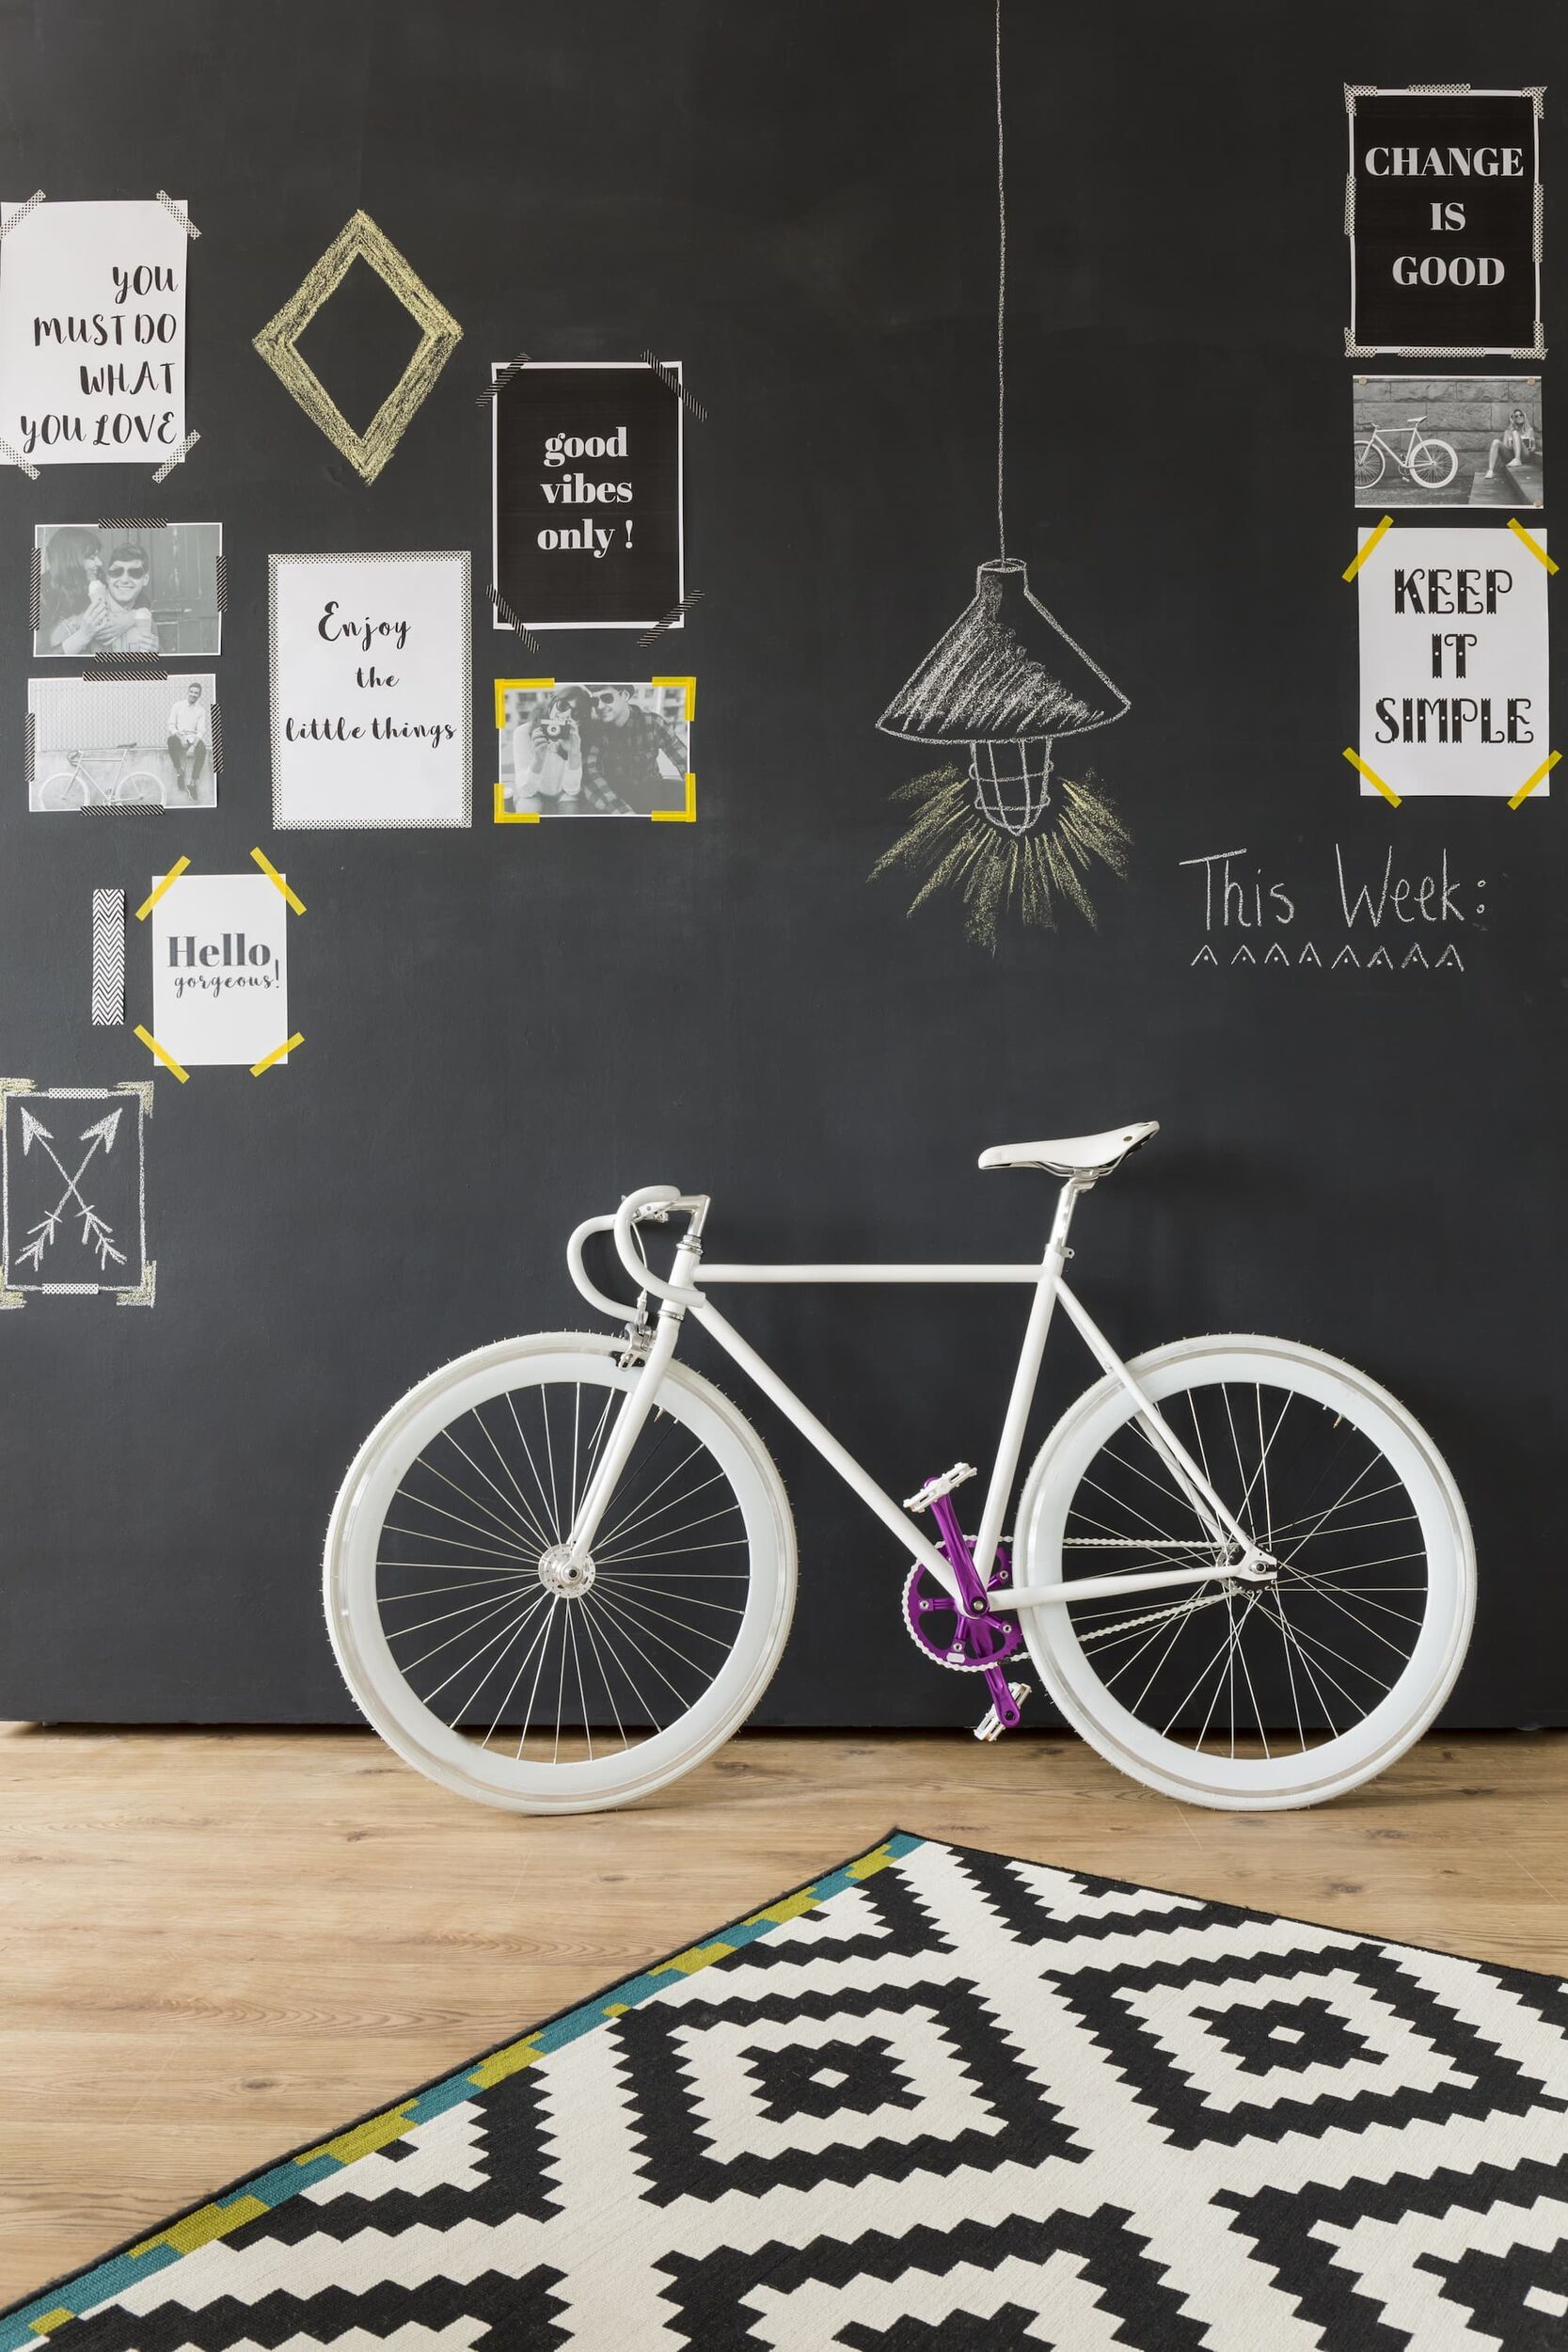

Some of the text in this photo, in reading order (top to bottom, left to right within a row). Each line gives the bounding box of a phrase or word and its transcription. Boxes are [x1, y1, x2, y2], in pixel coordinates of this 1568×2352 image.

[1365, 147, 1524, 177] CHANGE
[1429, 202, 1466, 231] IS
[112, 265, 179, 305] YOU
[1392, 256, 1505, 287] GOOD
[34, 313, 177, 347] MUST DO
[79, 360, 175, 396] WHAT
[20, 411, 176, 454] YOU LOVE
[543, 426, 629, 468] good
[539, 472, 633, 504] vibes
[537, 518, 616, 559] only
[1394, 568, 1513, 615] KEEP
[318, 600, 411, 652] Enjoy
[1432, 633, 1478, 679] IT
[356, 666, 399, 689] the
[285, 716, 454, 749] little things
[1374, 697, 1534, 744] SIMPLE
[1179, 843, 1486, 930] This Week:
[166, 931, 272, 968] Hello
[174, 959, 280, 999] gorgeous!
